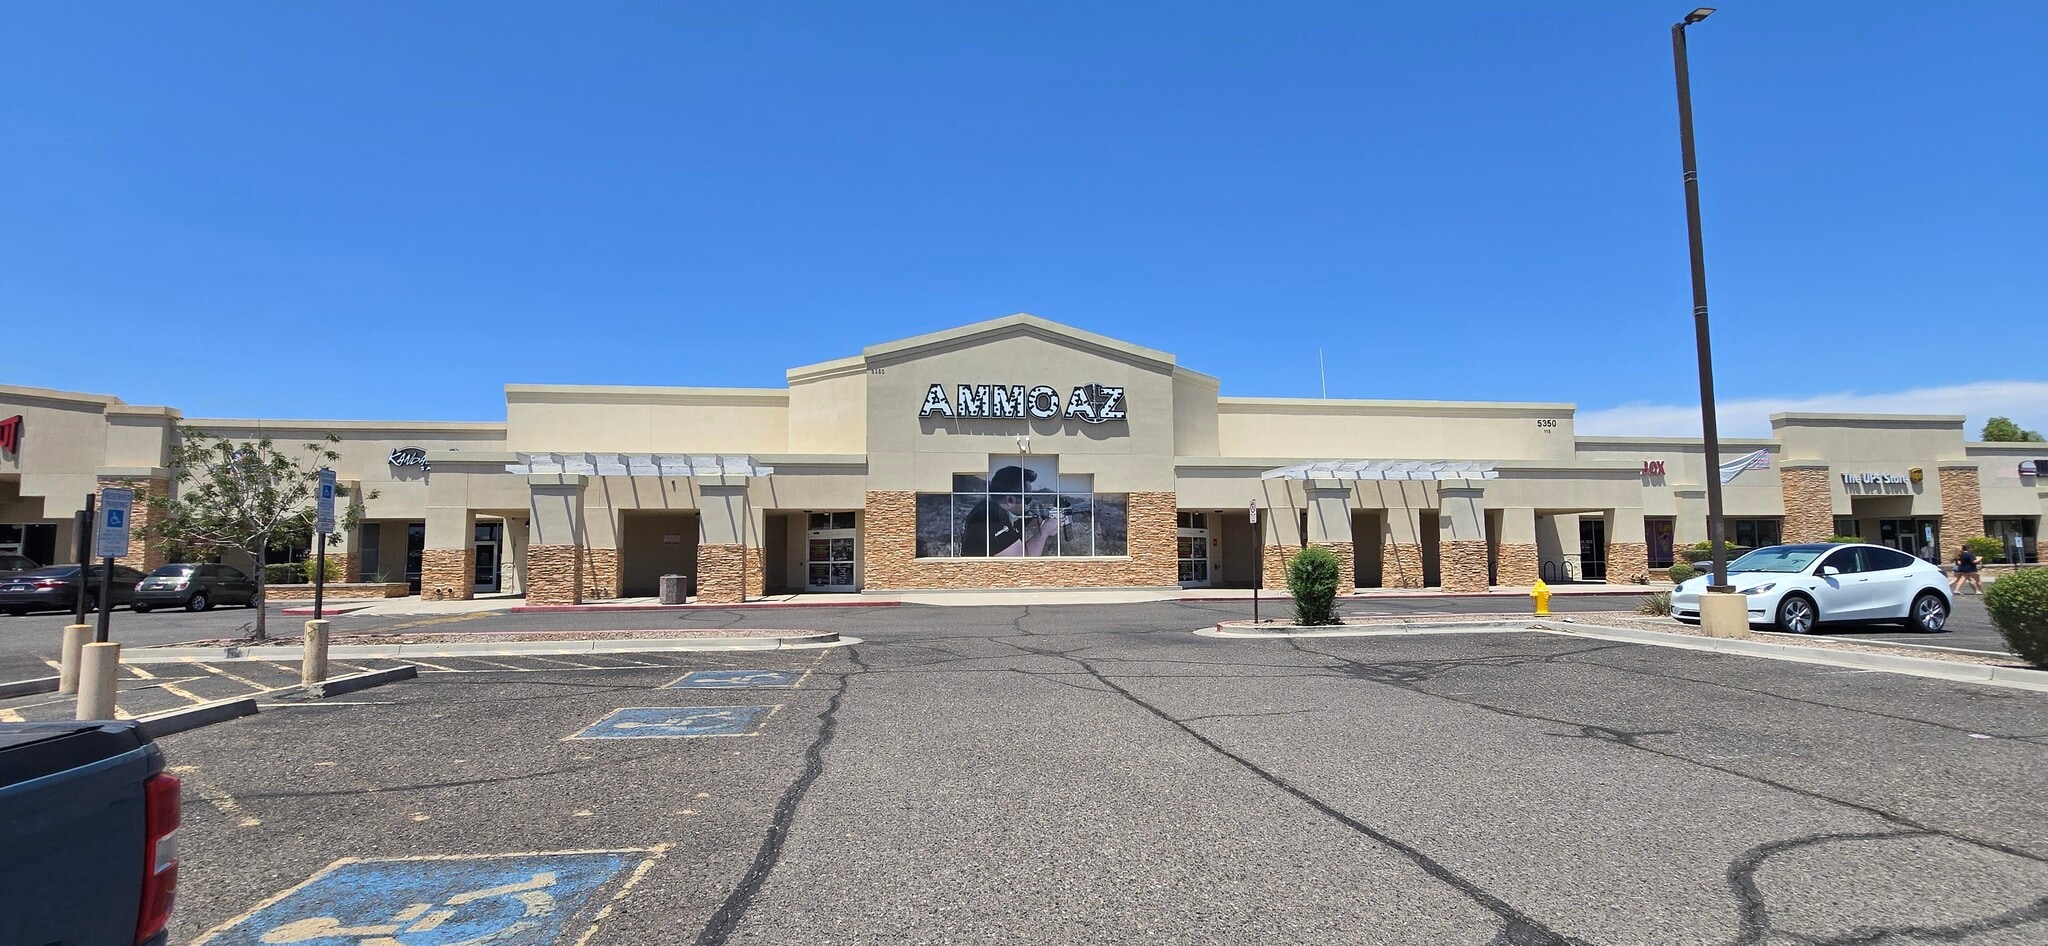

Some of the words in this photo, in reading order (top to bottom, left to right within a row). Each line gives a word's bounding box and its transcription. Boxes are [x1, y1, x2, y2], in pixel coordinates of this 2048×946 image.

[1537, 419, 1557, 427] 5350
[387, 448, 430, 467] KANDA
[1841, 473, 1860, 484] The
[1861, 473, 1881, 484] UPS
[1883, 473, 1908, 484] Store
